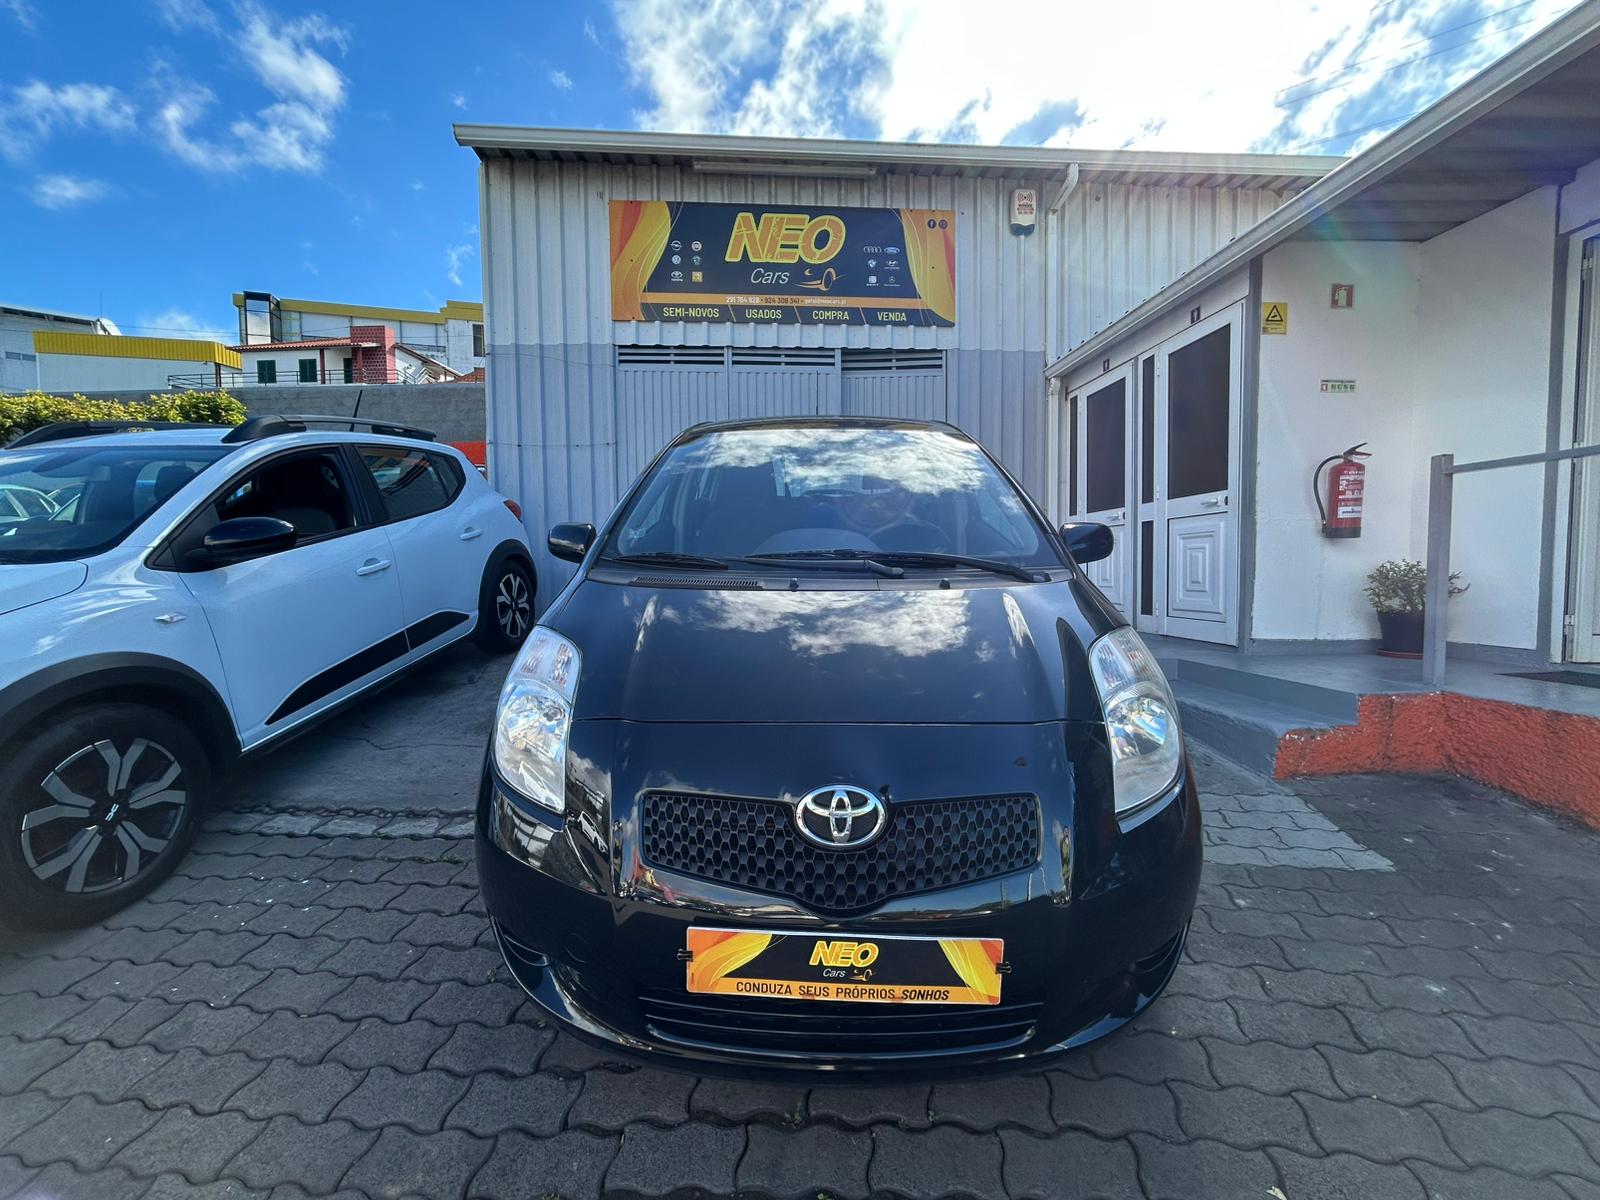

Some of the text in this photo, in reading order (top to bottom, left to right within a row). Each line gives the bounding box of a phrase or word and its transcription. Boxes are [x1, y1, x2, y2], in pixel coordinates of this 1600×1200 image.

[724, 212, 847, 264] NEO
[750, 268, 790, 285] Cars
[663, 307, 907, 321] SEMI-NOVOS USADOS COMPRA VENDA
[809, 940, 879, 968] NEO
[822, 968, 846, 978] Cars
[736, 981, 950, 1001] CONDUZA SEUS PRÓPRIOS SONHOS
